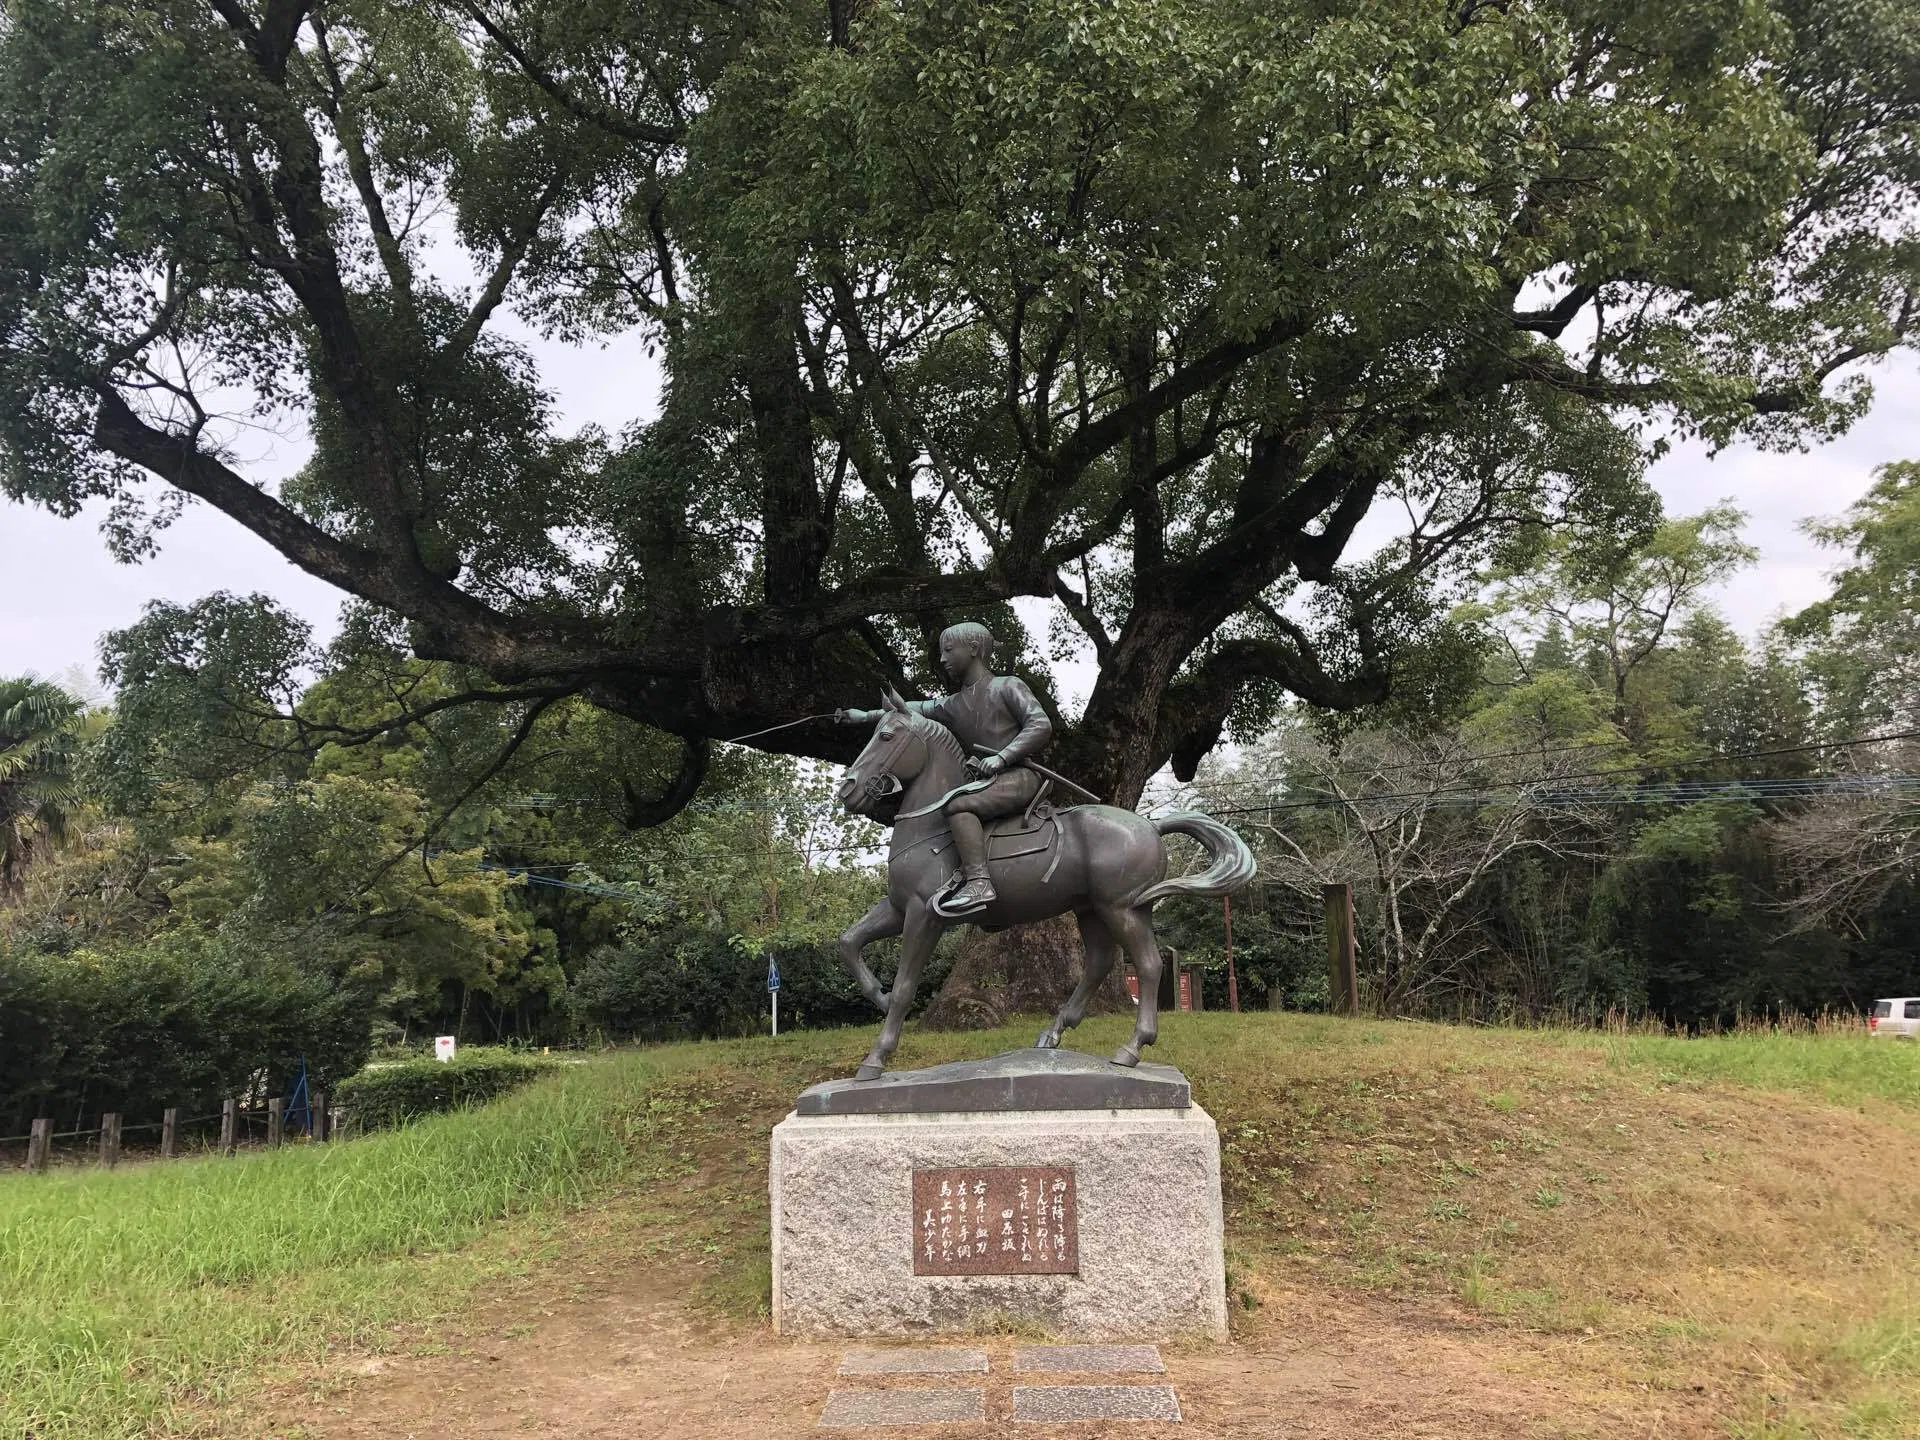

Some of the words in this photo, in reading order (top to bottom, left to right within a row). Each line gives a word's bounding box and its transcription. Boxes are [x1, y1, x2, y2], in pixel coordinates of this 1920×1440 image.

[922, 1208, 936, 1262] 美少年
[939, 1180, 954, 1261] 馬上ゆたかな
[957, 1180, 971, 1258] 左手に手綱
[973, 1180, 989, 1254] 右手に血刀
